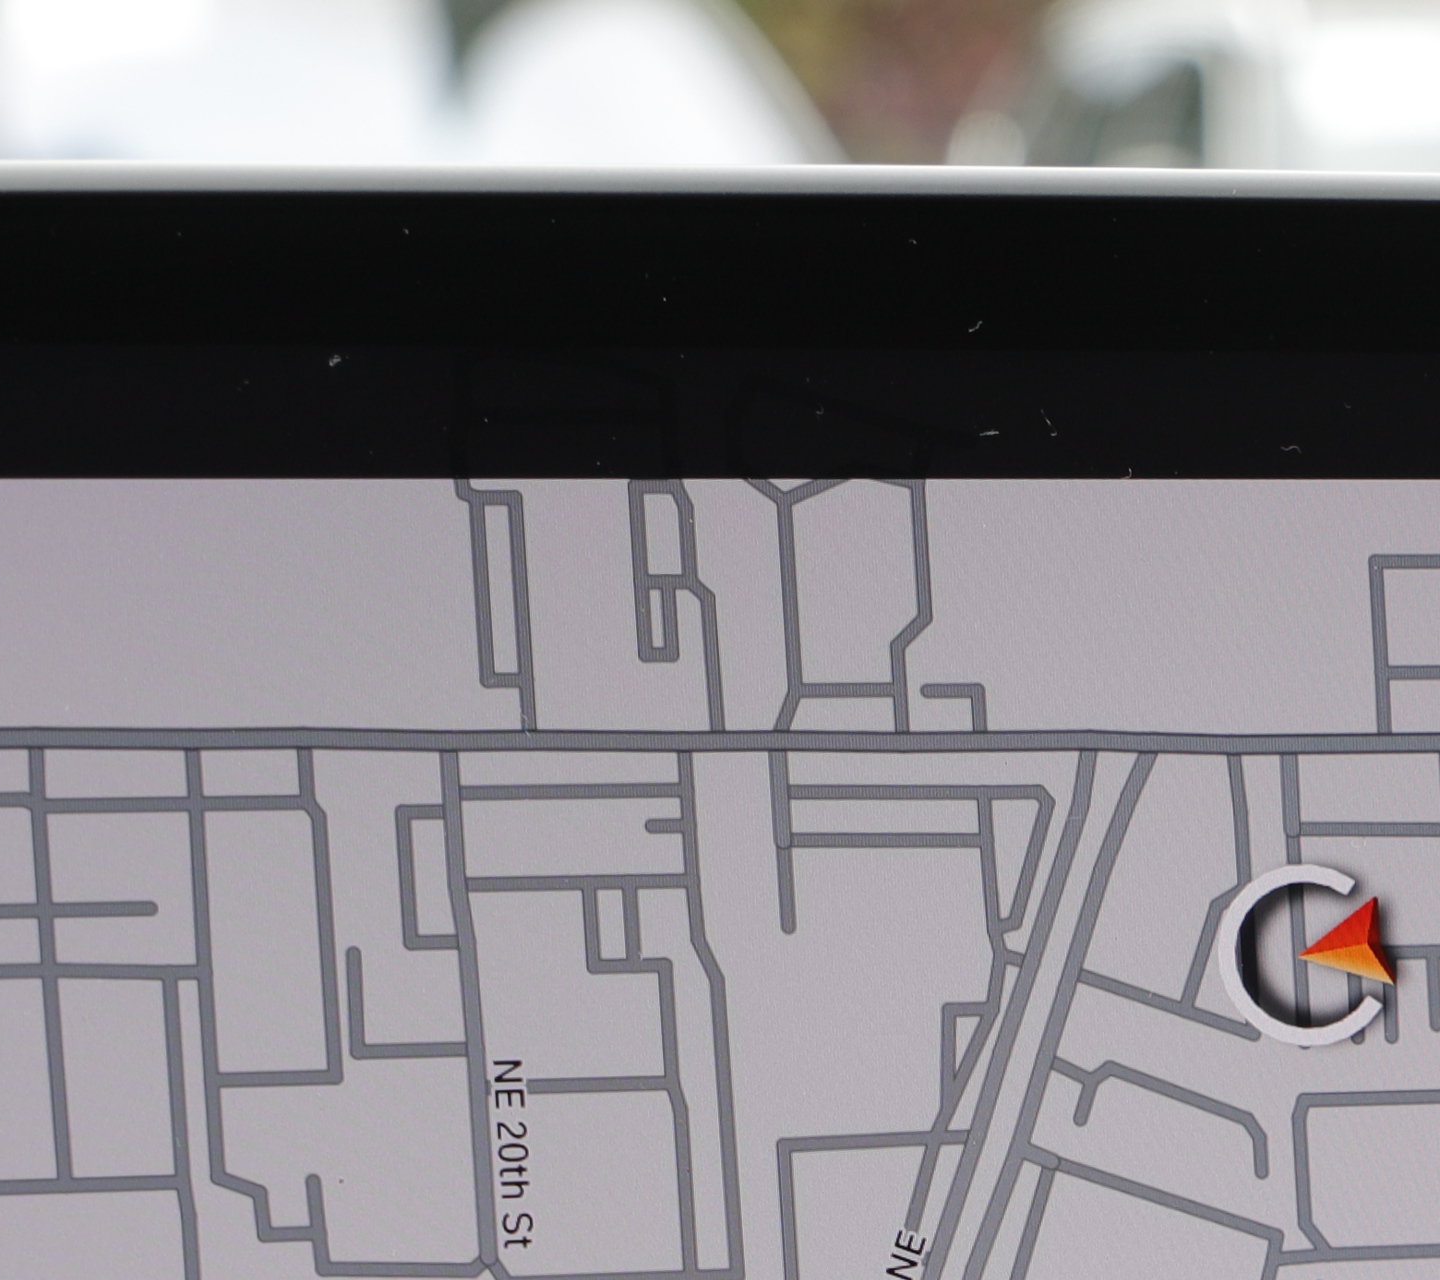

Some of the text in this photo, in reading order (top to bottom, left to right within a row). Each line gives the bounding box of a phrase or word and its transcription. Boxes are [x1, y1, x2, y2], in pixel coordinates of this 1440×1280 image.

[492, 1060, 535, 1249] NE 20th St
